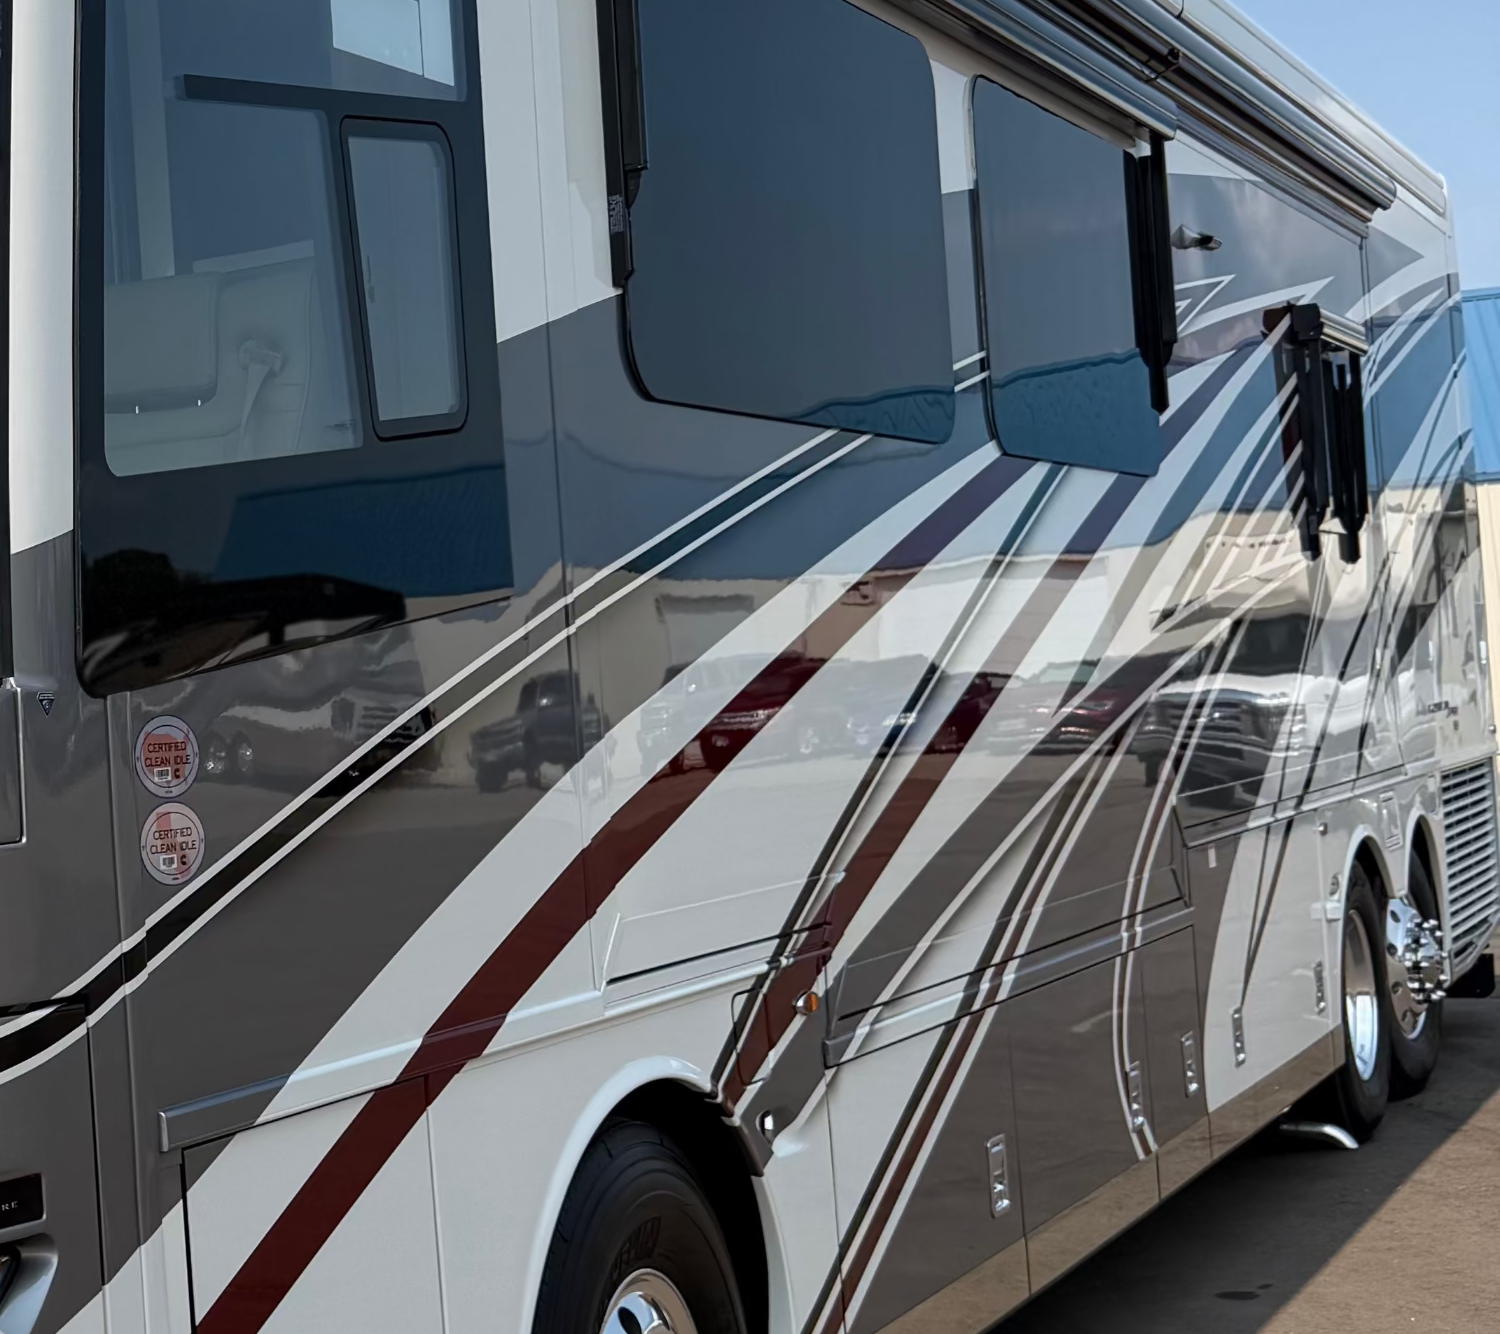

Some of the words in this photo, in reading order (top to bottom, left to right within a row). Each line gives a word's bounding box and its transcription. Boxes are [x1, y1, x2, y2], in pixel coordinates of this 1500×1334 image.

[147, 740, 187, 754] CERTIFIED
[144, 755, 171, 768] CLEAN
[174, 754, 192, 766] IDLE
[153, 826, 193, 841] CERTIFIED
[150, 842, 177, 855] CLEAN
[179, 840, 197, 851] IDLE
